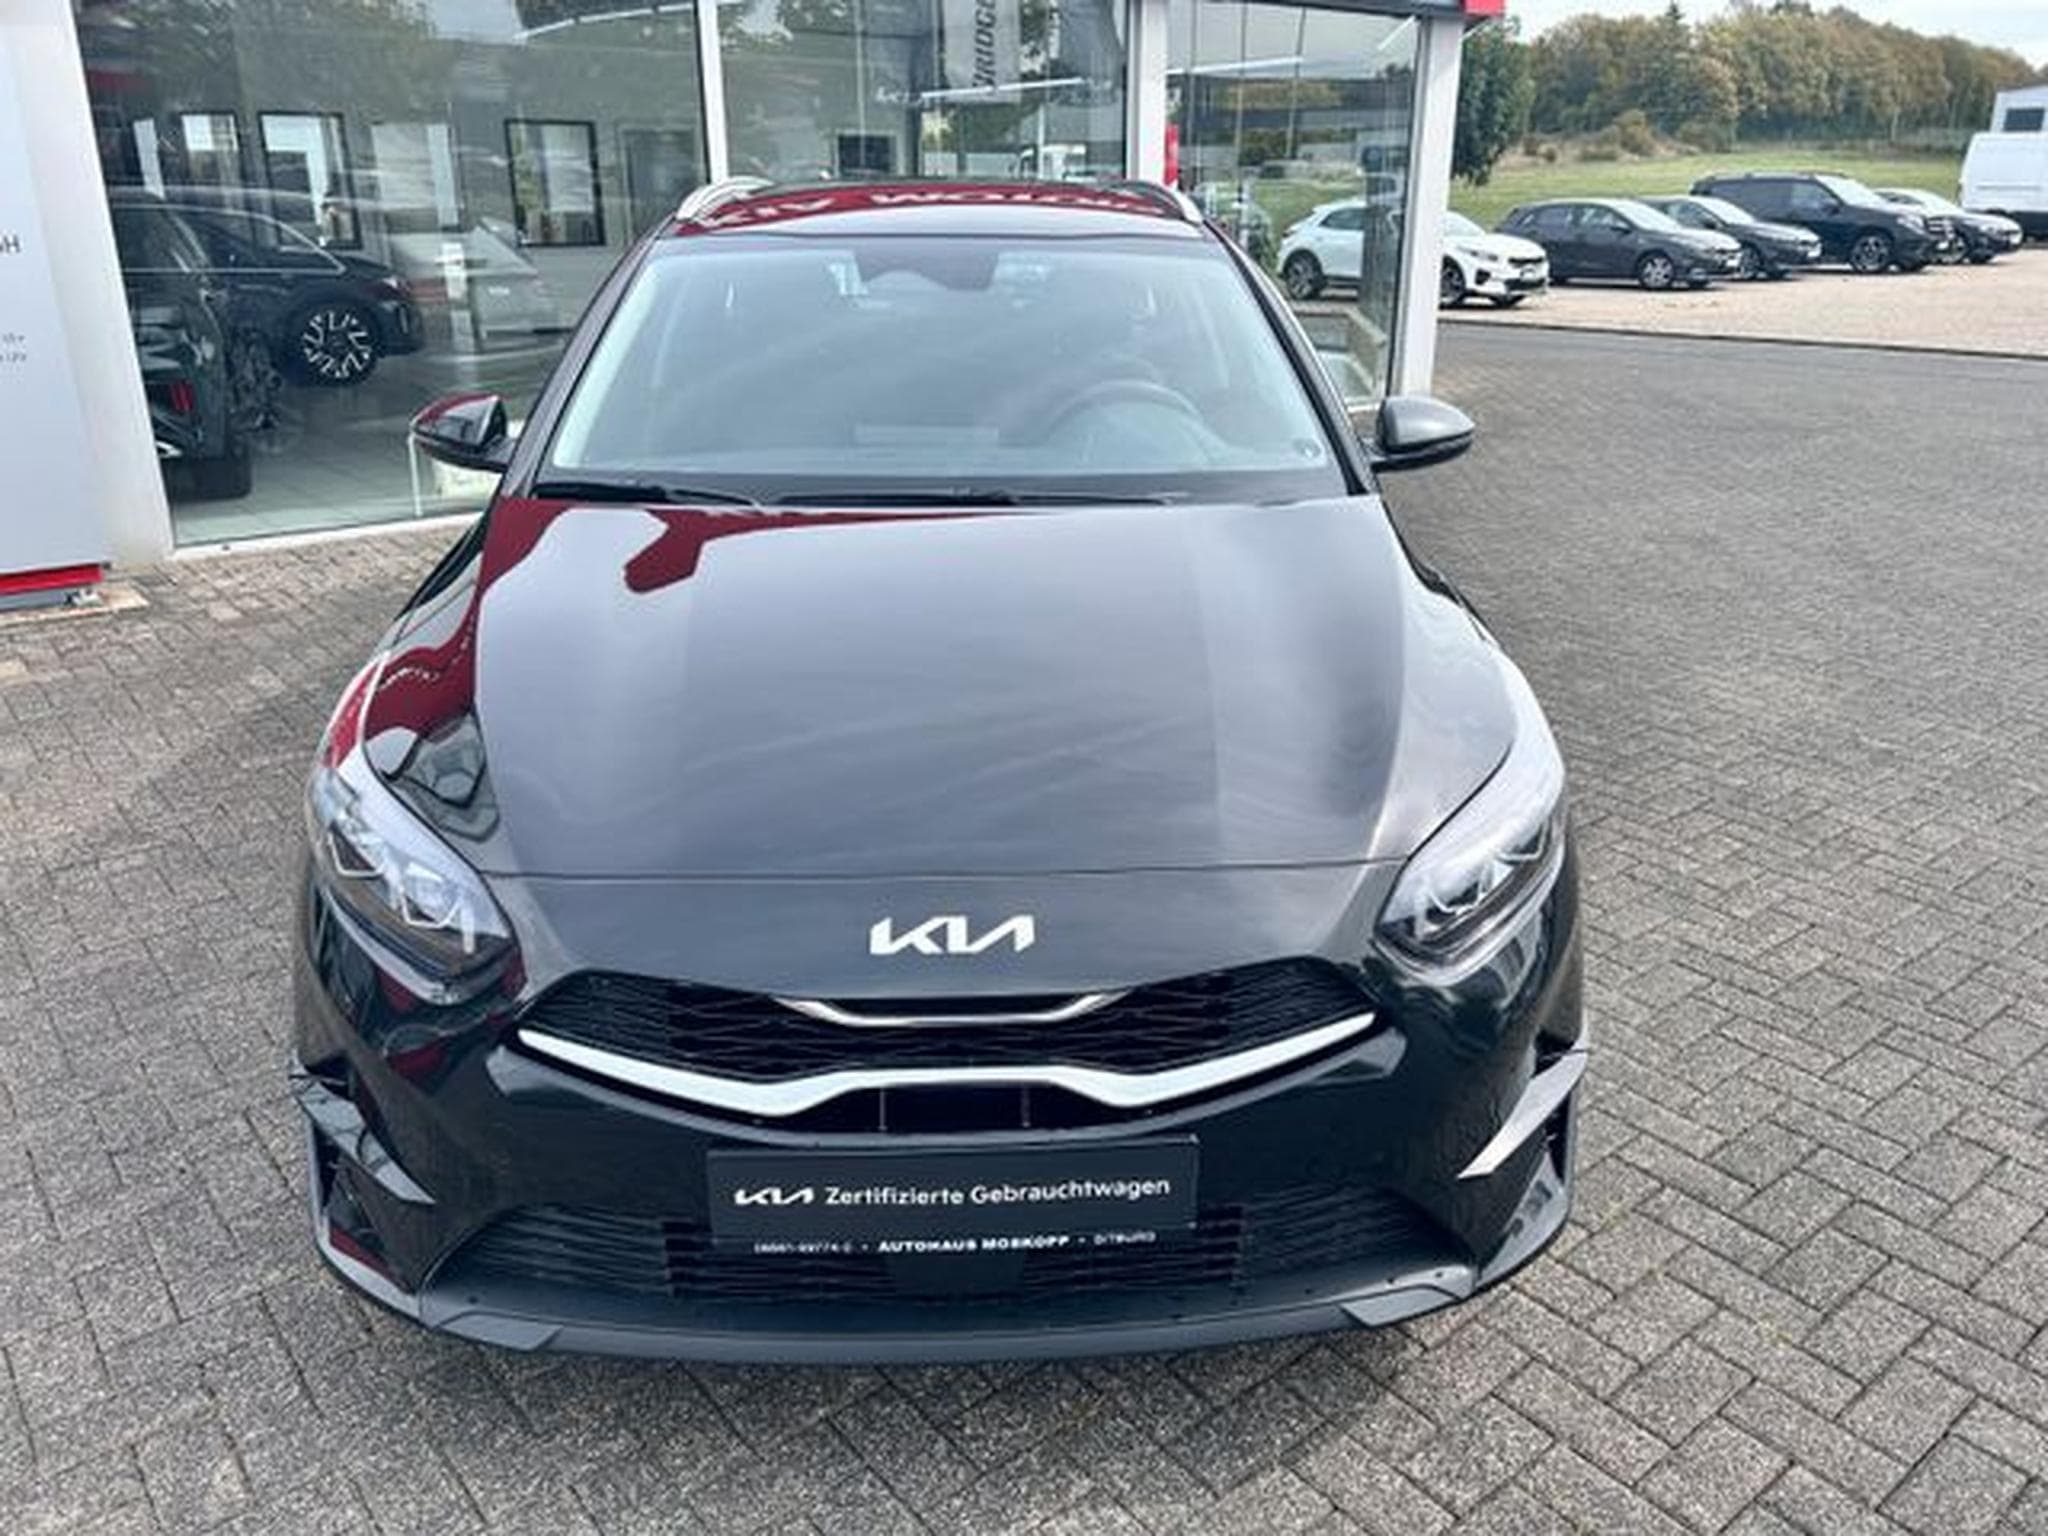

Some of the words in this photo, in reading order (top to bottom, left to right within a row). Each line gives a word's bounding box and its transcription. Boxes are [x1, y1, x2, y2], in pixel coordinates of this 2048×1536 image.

[869, 915, 1035, 955] KIA
[734, 1187, 815, 1205] KIA
[824, 1186, 965, 1205] Zertifizierte
[970, 1179, 1171, 1205] Gebrauchtwagen
[877, 1239, 977, 1253] AUTOHAUS
